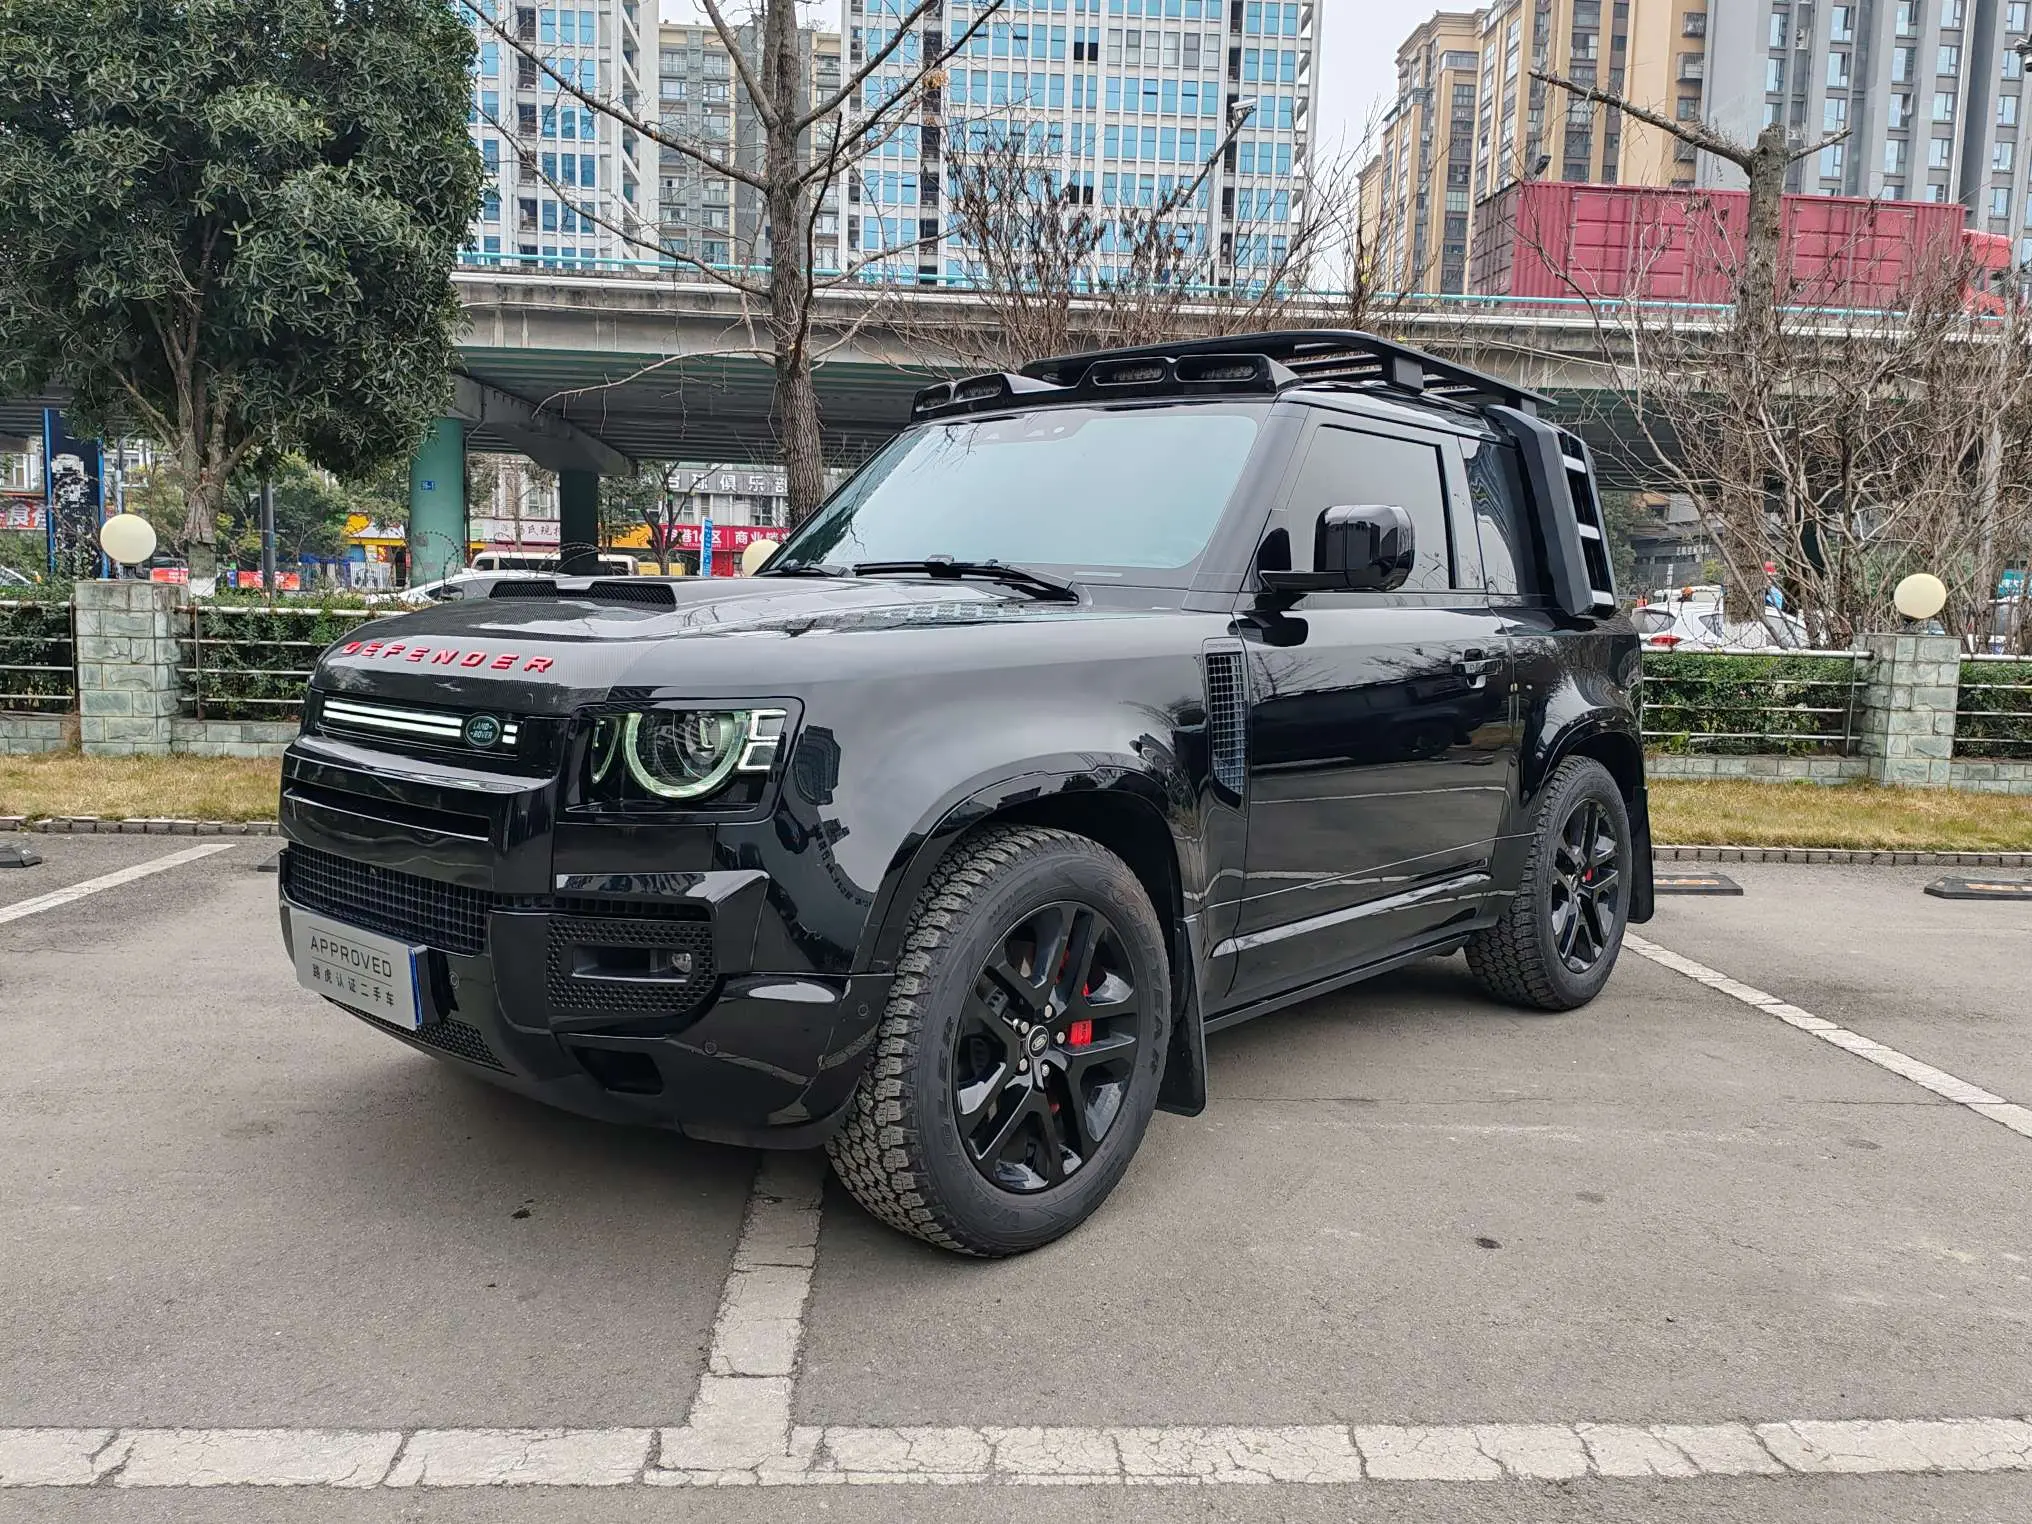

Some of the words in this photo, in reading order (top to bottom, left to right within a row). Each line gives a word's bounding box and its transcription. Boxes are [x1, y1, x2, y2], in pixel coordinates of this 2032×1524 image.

[341, 641, 554, 673] DEFENDER
[472, 721, 490, 731] LAND
[472, 730, 493, 739] ROVER
[310, 935, 392, 978] APPROVED
[312, 963, 395, 1007] 路虎认证二手车
